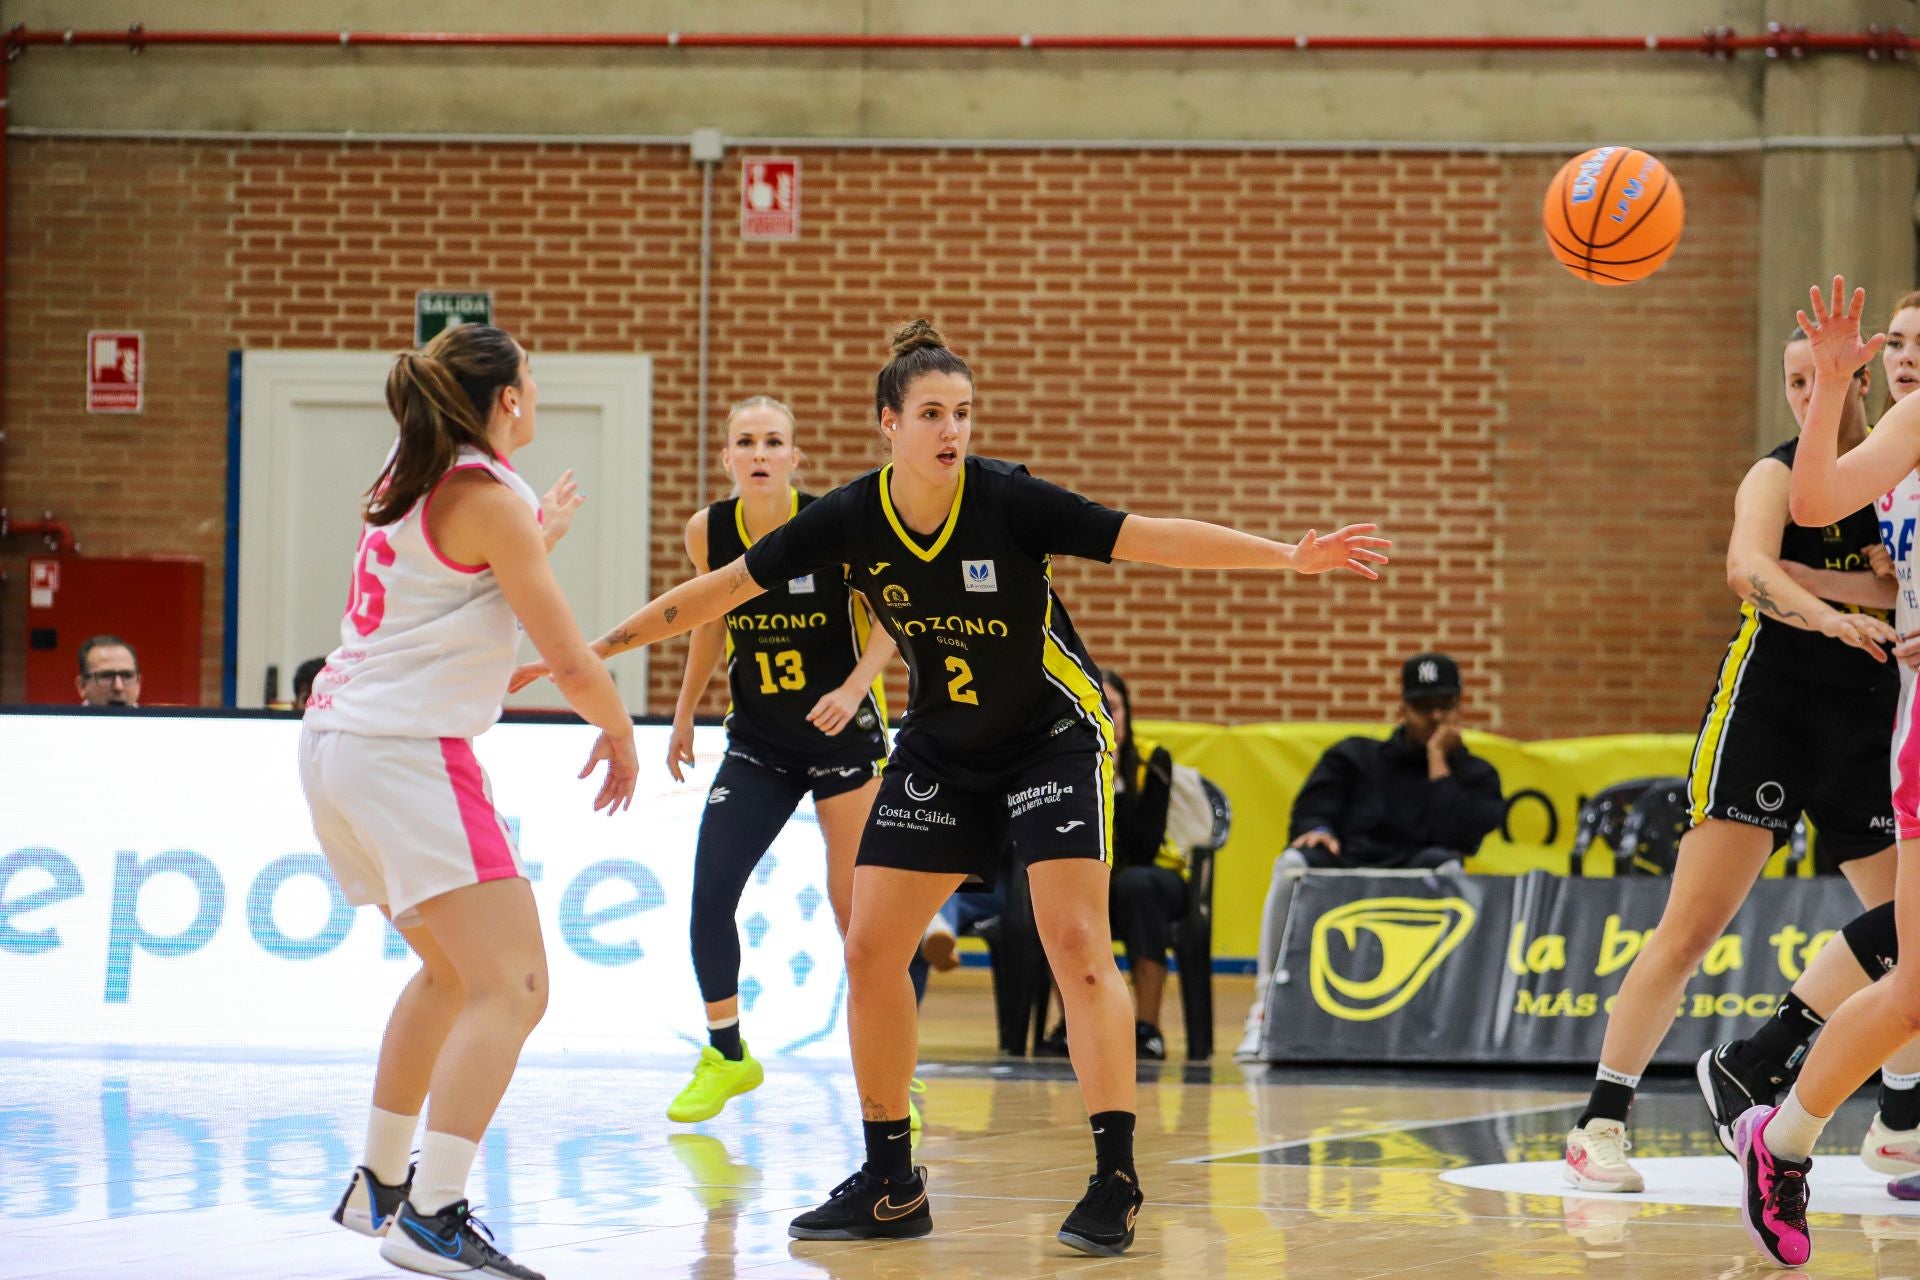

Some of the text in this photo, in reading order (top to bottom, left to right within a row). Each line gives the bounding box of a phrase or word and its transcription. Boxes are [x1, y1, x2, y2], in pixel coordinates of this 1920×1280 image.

[420, 294, 487, 312] SALIDA
[727, 612, 827, 630] HOZONO
[936, 635, 969, 650] GLOBAL
[755, 649, 806, 694] 13
[944, 655, 979, 706] 2
[878, 804, 957, 826] Costa Cálida
[1727, 806, 1760, 824] Costa
[906, 822, 929, 832] Murcia
[0, 818, 666, 1004] epoe
[1507, 920, 1566, 976] la
[1515, 988, 1599, 1017] MÁS
[1689, 992, 1786, 1018] BOC
